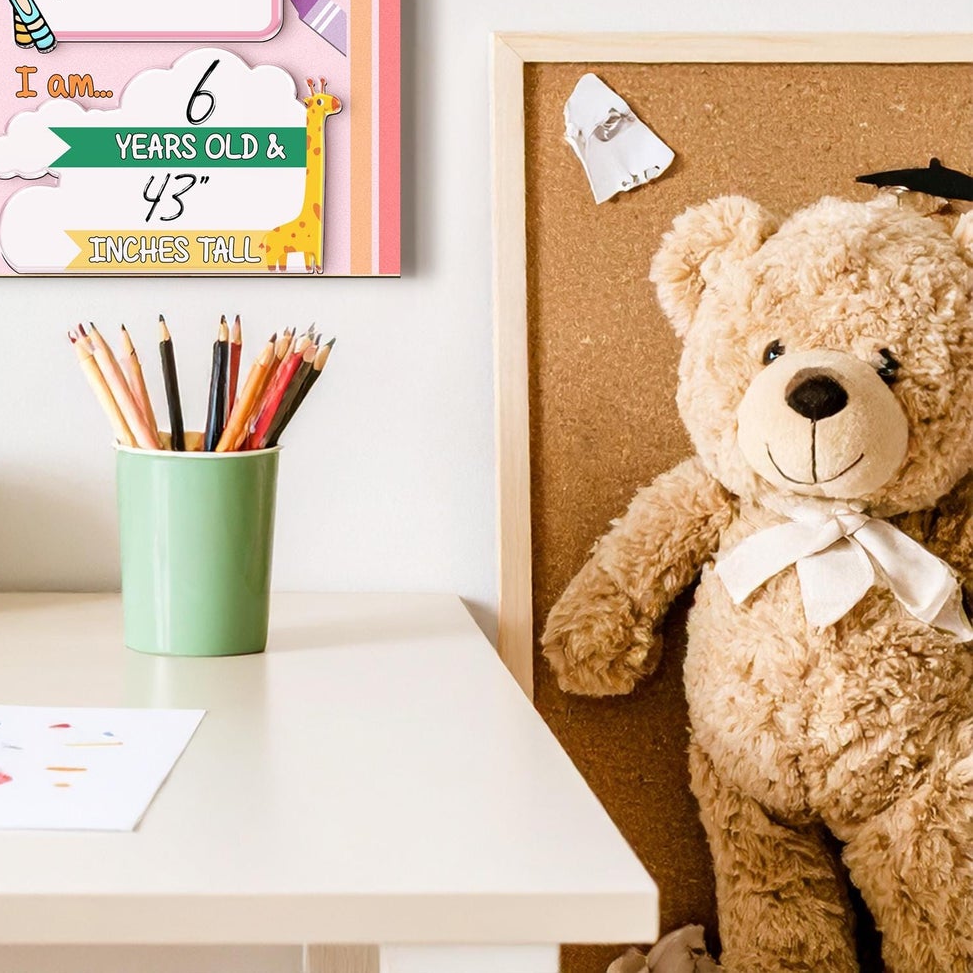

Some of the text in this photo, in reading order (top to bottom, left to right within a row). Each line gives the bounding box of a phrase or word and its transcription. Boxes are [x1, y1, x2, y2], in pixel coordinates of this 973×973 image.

[15, 65, 114, 98] I am...
[186, 59, 220, 125] 6
[115, 133, 287, 161] YEARS OLD &
[88, 236, 262, 263] INCHES TALL
